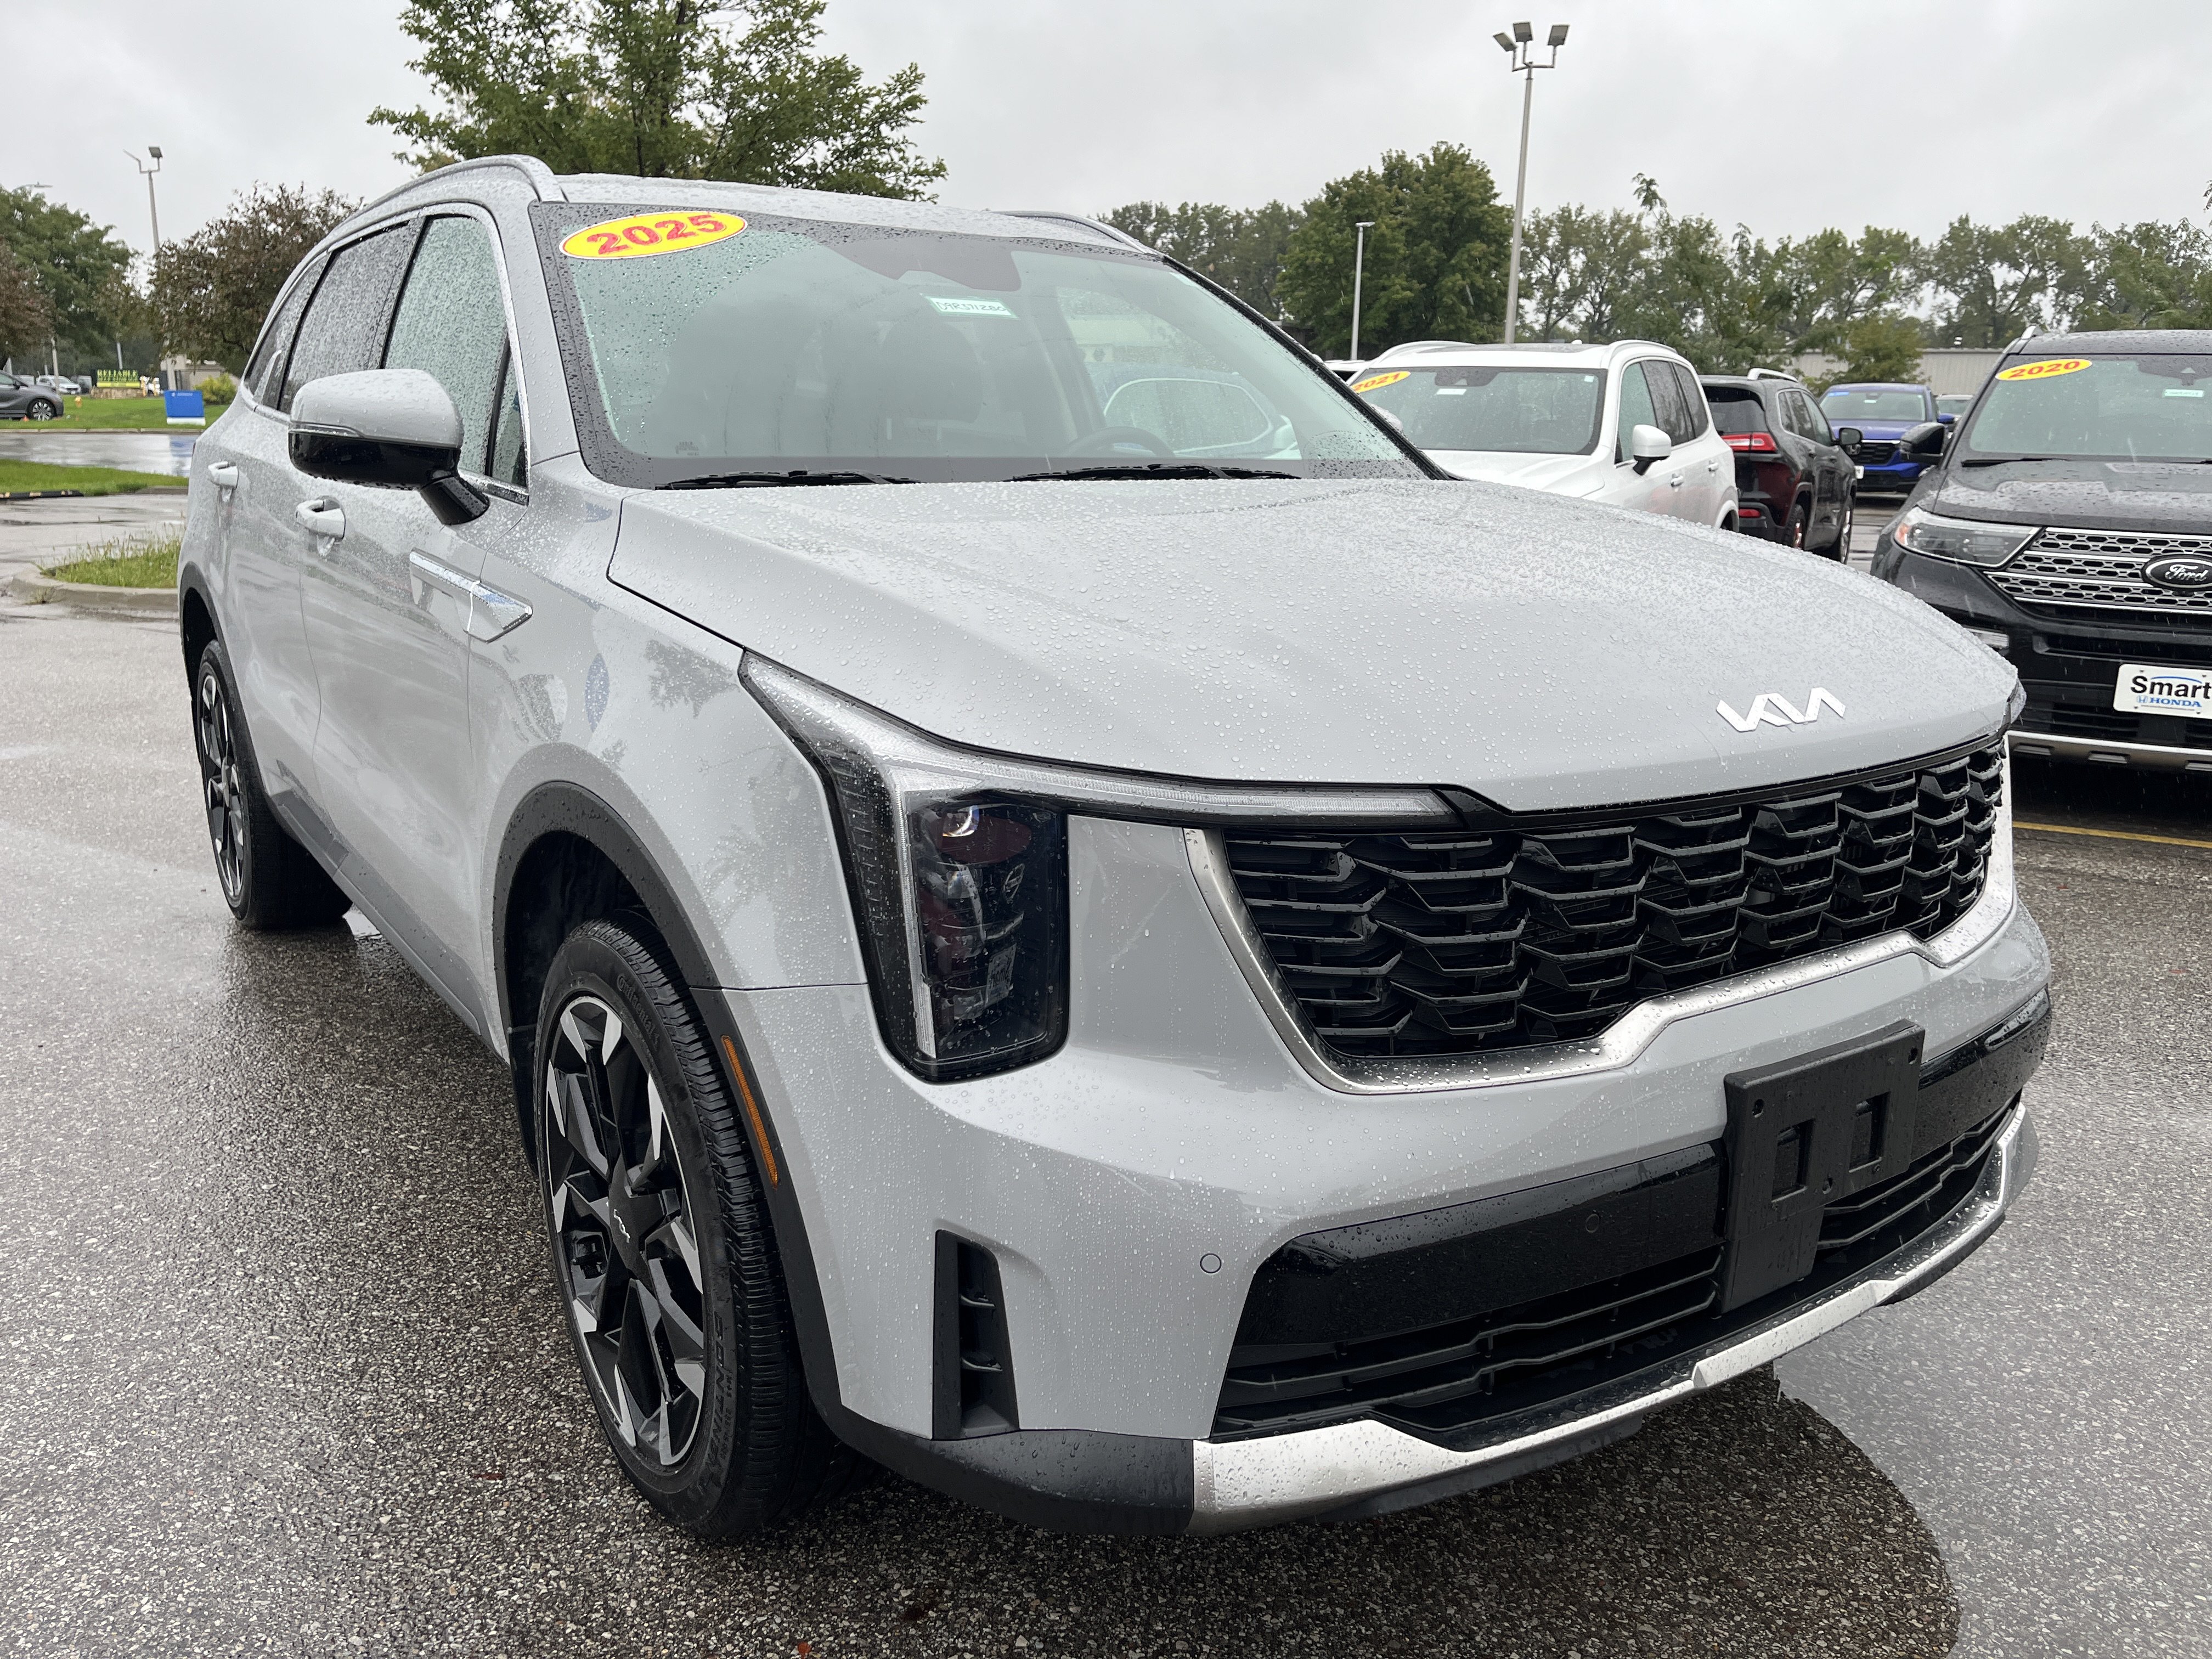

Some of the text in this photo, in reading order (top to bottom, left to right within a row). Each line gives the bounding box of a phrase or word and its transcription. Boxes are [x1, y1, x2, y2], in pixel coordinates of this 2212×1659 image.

[587, 215, 726, 255] 2025
[2008, 361, 2081, 379] 2020
[1354, 373, 1400, 391] 2021
[2164, 564, 2209, 582] Ford
[2130, 675, 2212, 699] Smart
[1716, 687, 1846, 732] KIA
[2149, 697, 2202, 708] HONDA
